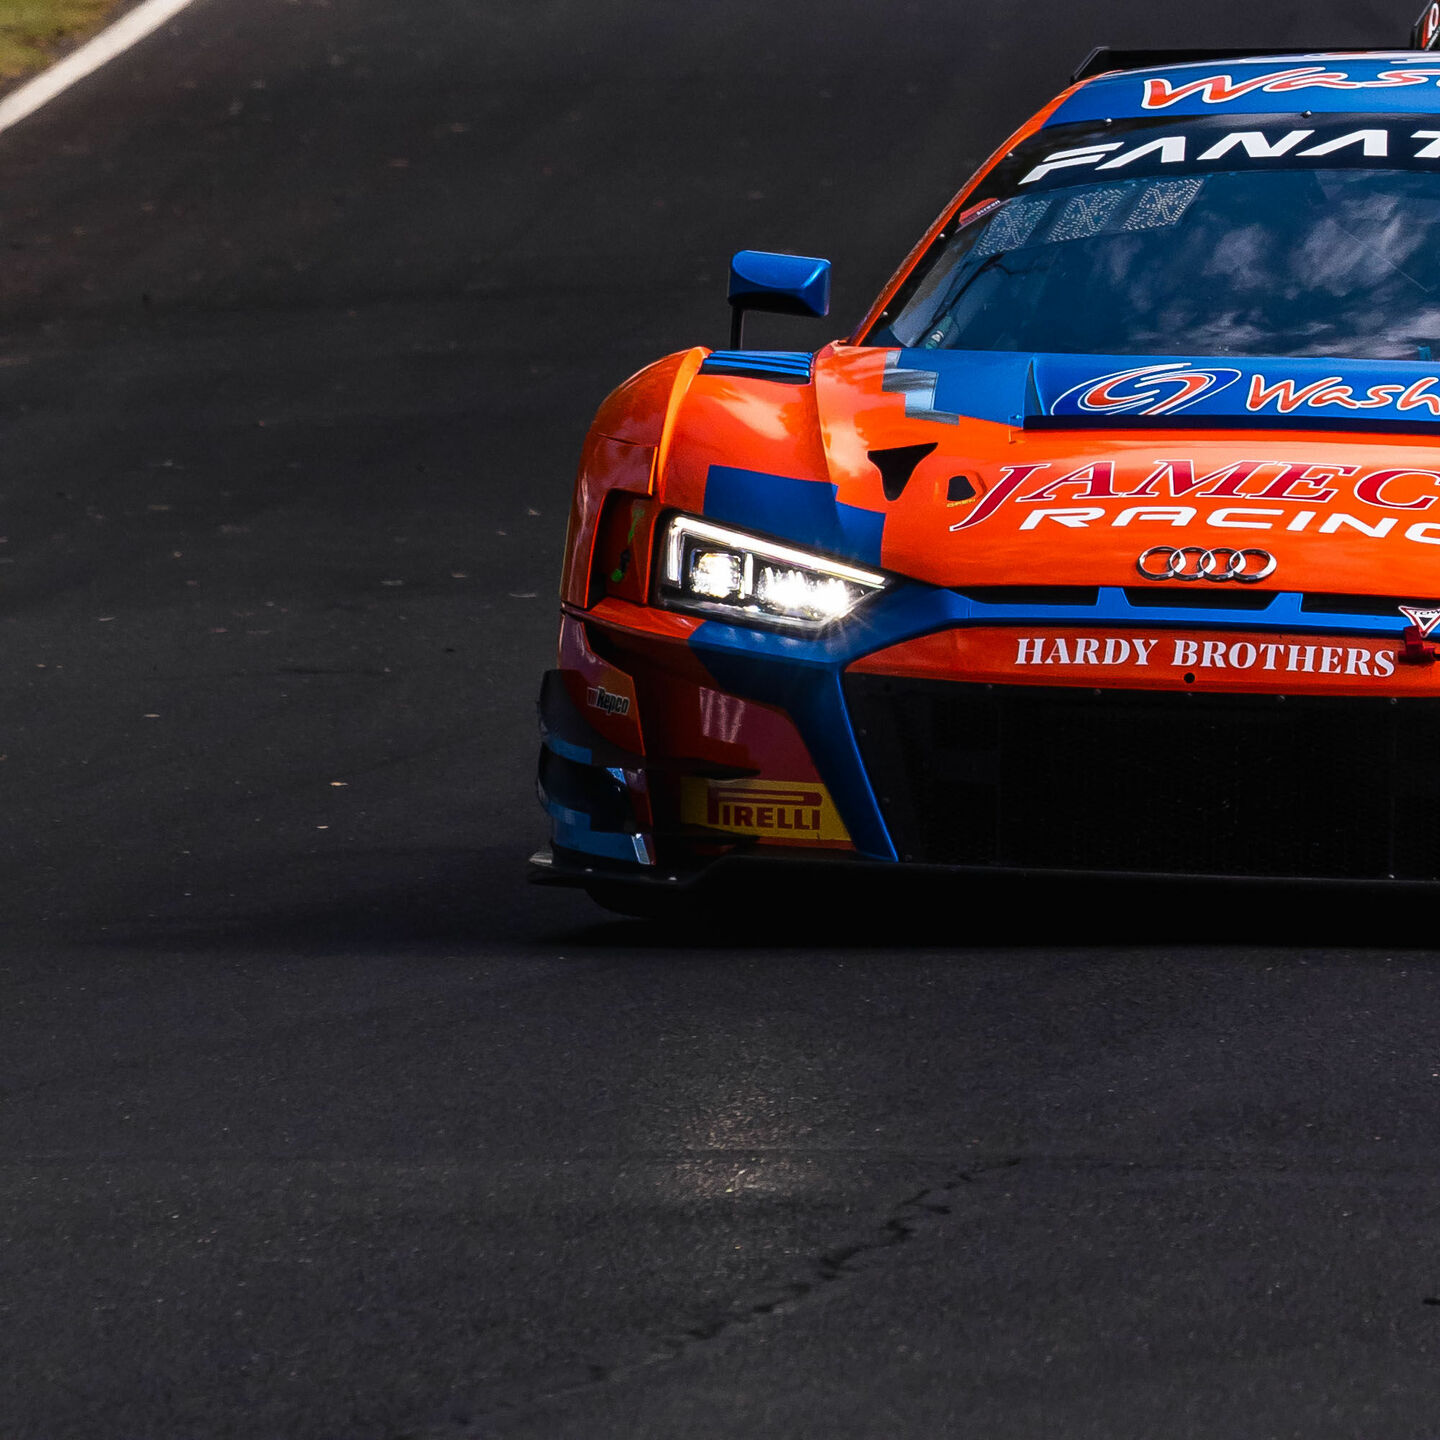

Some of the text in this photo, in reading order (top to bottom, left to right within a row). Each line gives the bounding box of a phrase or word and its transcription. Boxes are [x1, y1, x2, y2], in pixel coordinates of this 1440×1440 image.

[1014, 638, 1397, 677] HARDY BROTHERS
[596, 686, 630, 715] Repco
[708, 787, 823, 831] PIRELLI
